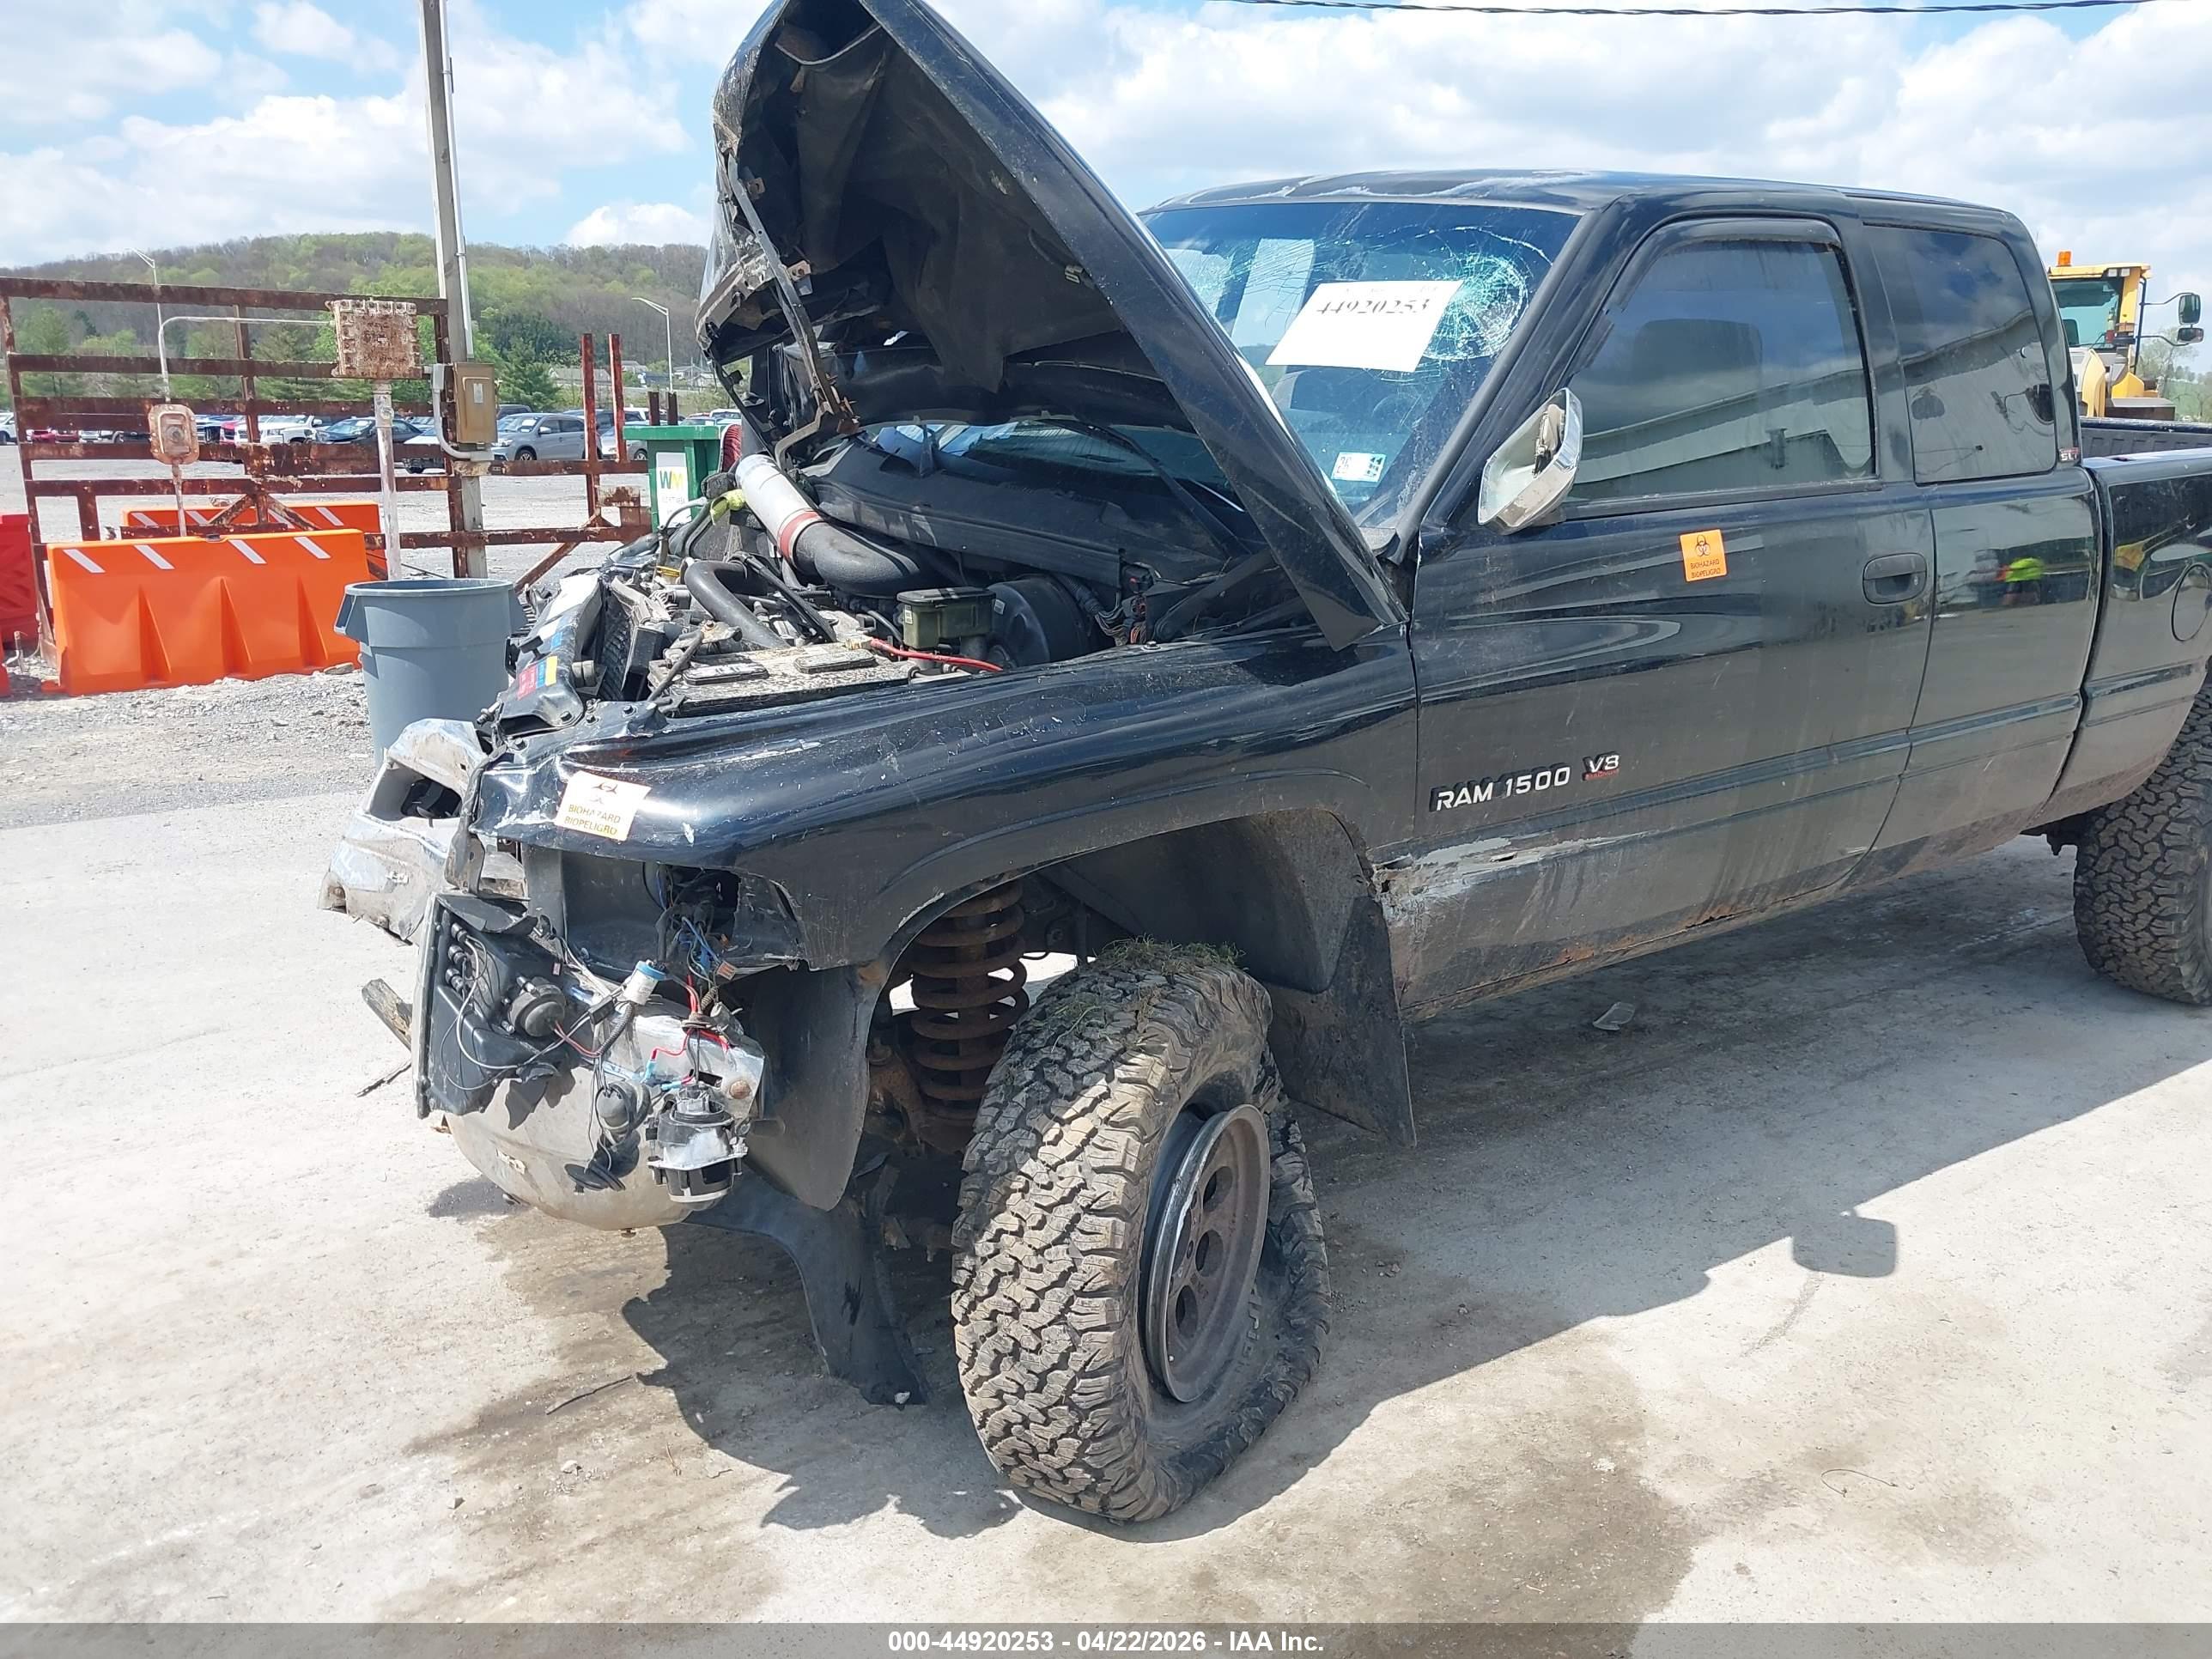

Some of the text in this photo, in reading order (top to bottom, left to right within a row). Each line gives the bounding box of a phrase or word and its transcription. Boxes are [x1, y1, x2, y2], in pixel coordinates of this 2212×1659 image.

[1690, 559, 1720, 569] BIOHAZARD
[1691, 568, 1722, 579] BIOPELIGRO
[1437, 755, 1620, 811] RAM 1500 V8
[568, 804, 621, 823] BIOHAZARD
[564, 816, 618, 836] BIOPELIGRO
